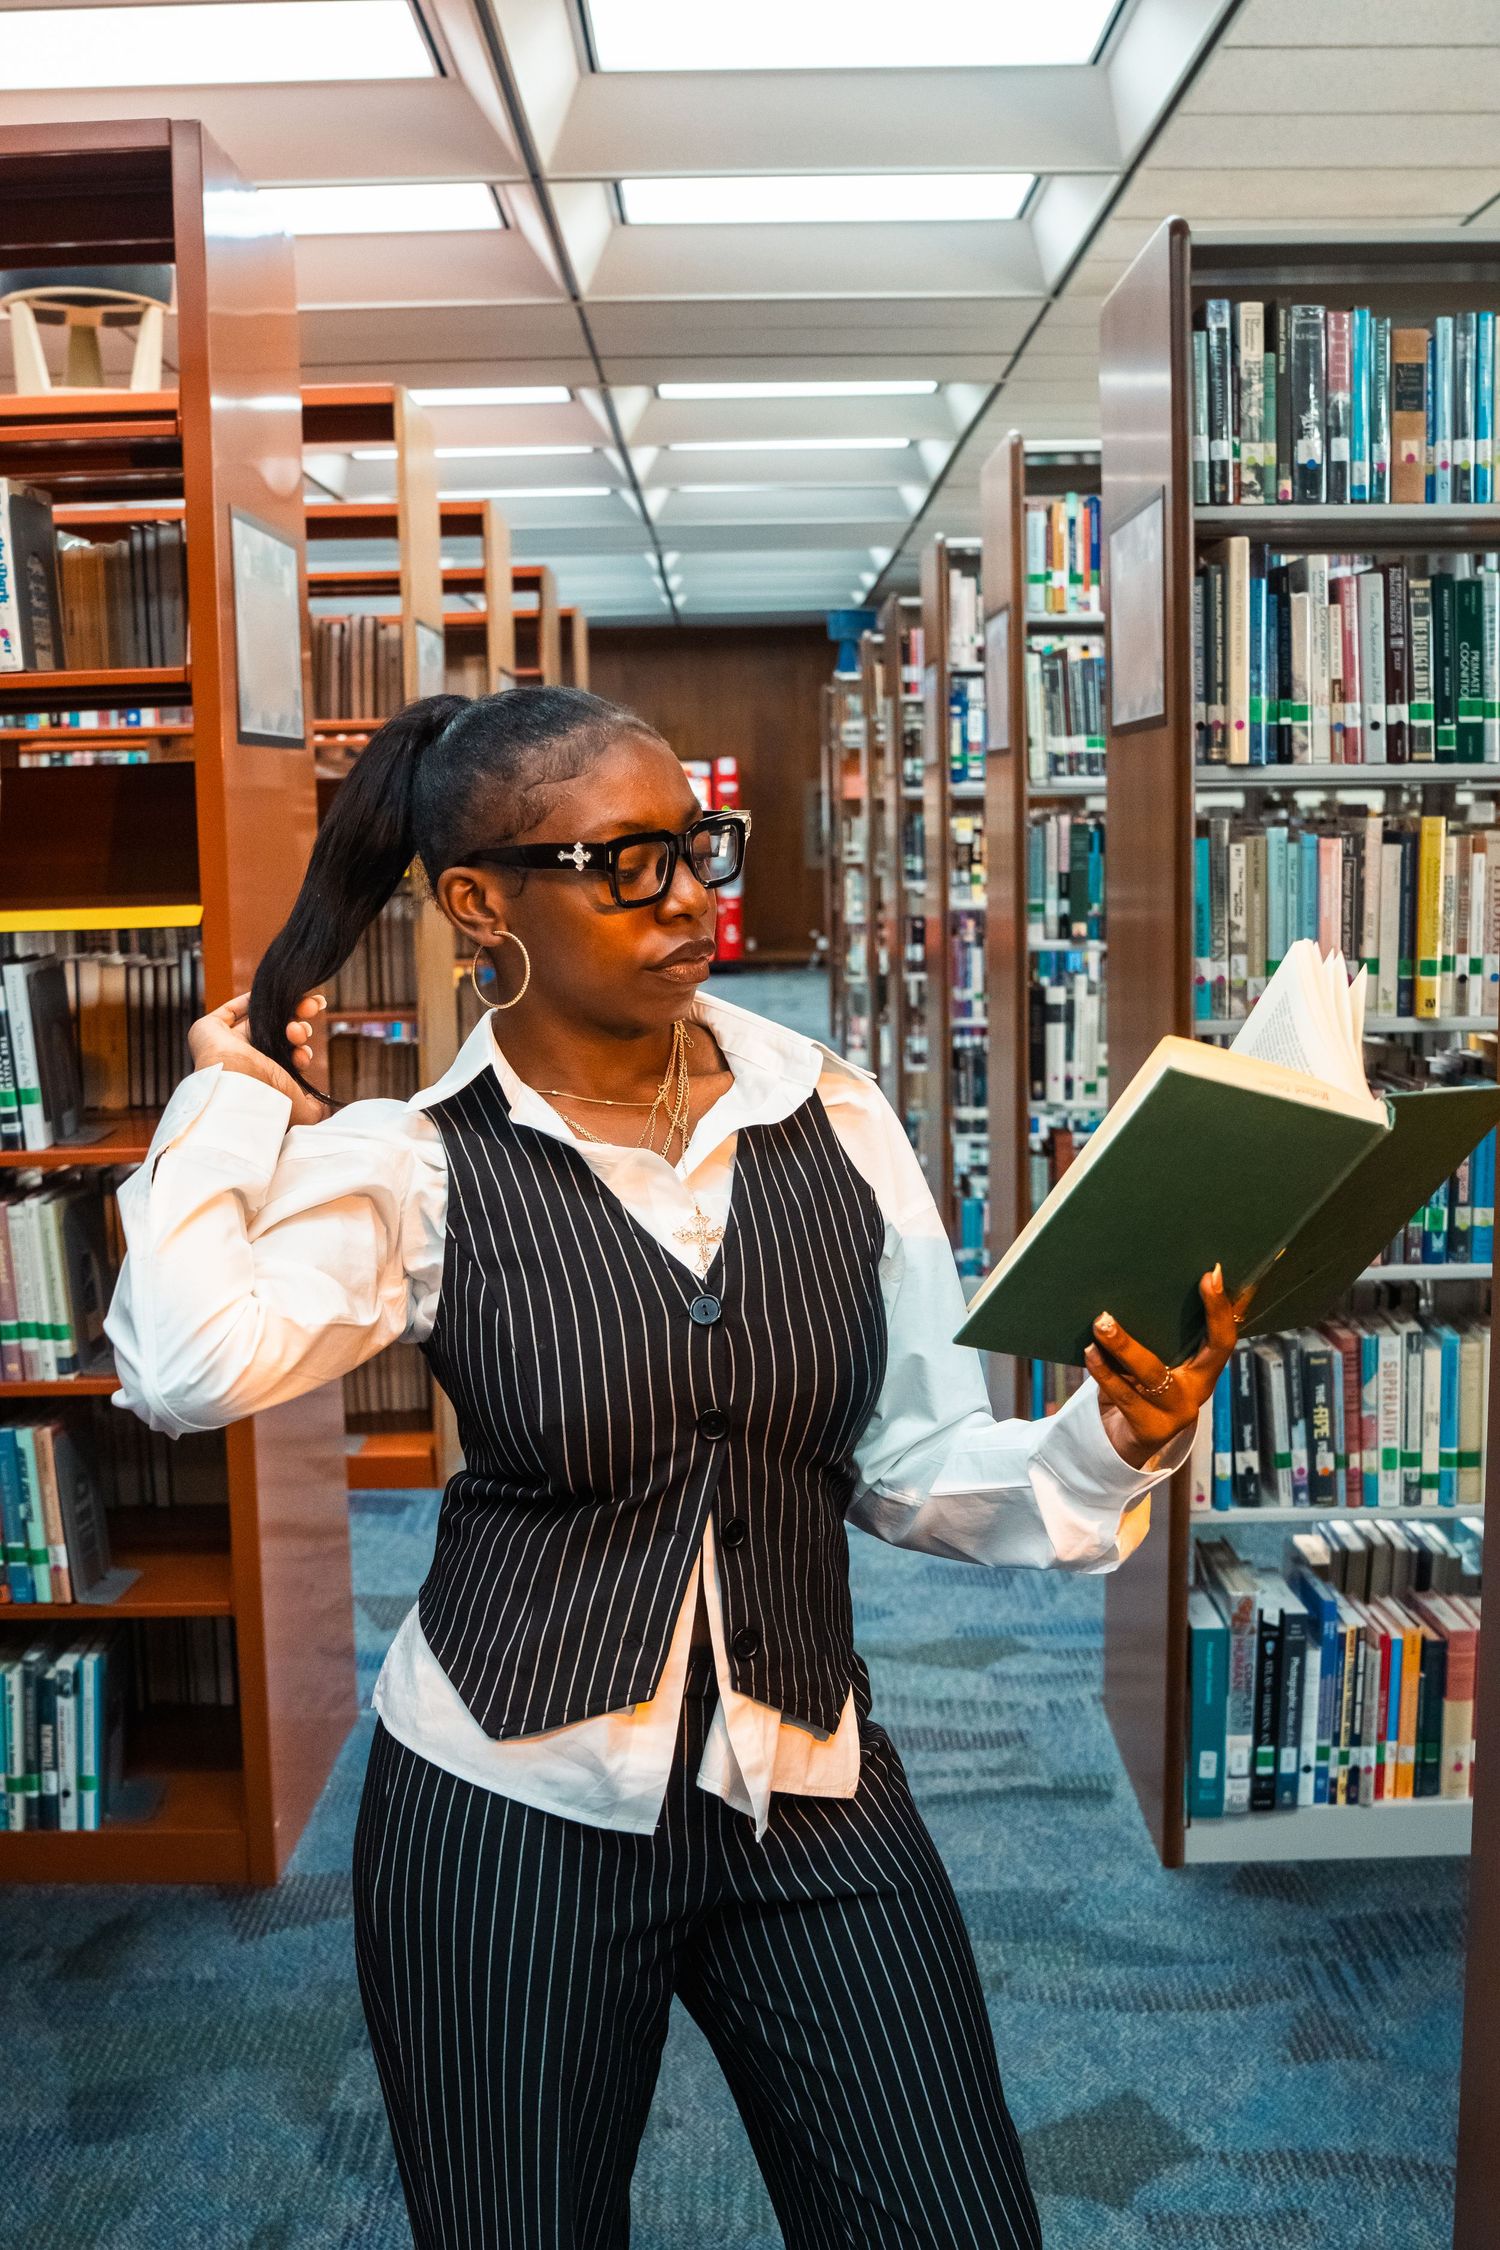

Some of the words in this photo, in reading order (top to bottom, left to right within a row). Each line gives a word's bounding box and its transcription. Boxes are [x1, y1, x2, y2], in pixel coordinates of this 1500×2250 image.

[1460, 641, 1470, 699] COGNITIO
[1471, 650, 1481, 694] PRIMATE
[1315, 1383, 1325, 1404] THE
[1383, 1360, 1398, 1442] SUPERLATIVE
[1312, 1405, 1330, 1440] APE
